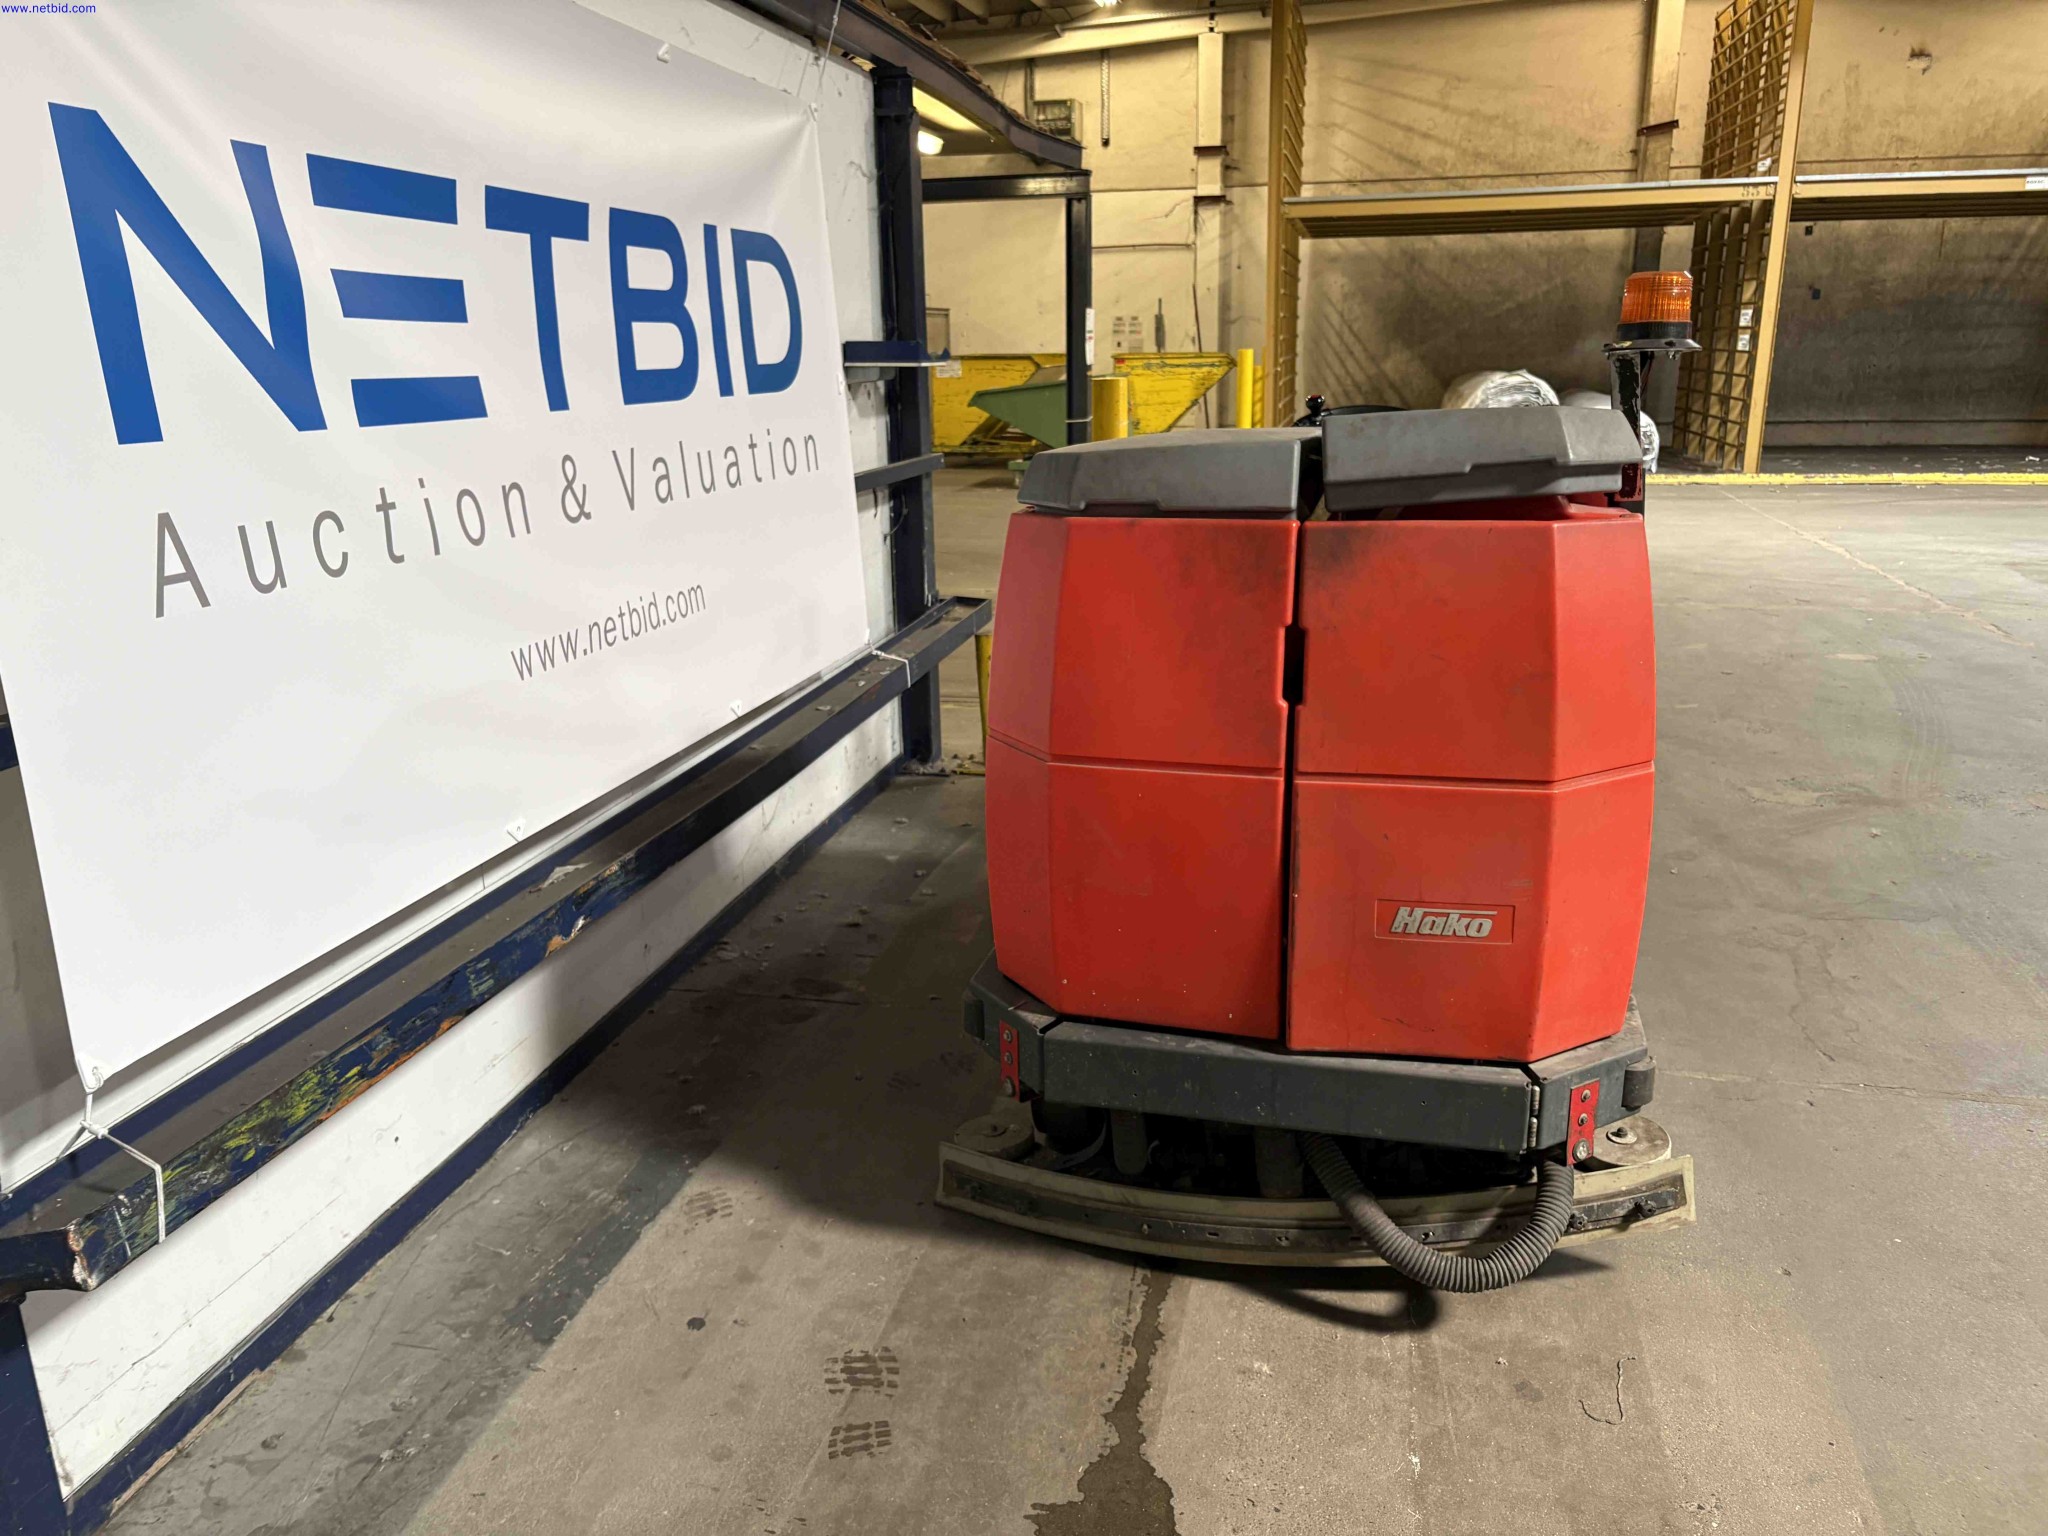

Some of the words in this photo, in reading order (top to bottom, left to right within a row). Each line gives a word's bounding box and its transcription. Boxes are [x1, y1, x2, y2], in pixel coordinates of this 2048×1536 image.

[48, 102, 802, 445] NETBID
[155, 477, 531, 618] Auction
[560, 454, 592, 523] &
[612, 429, 820, 512] Valuation
[511, 584, 706, 681] www.netbid.com
[1391, 906, 1497, 938] Hako
